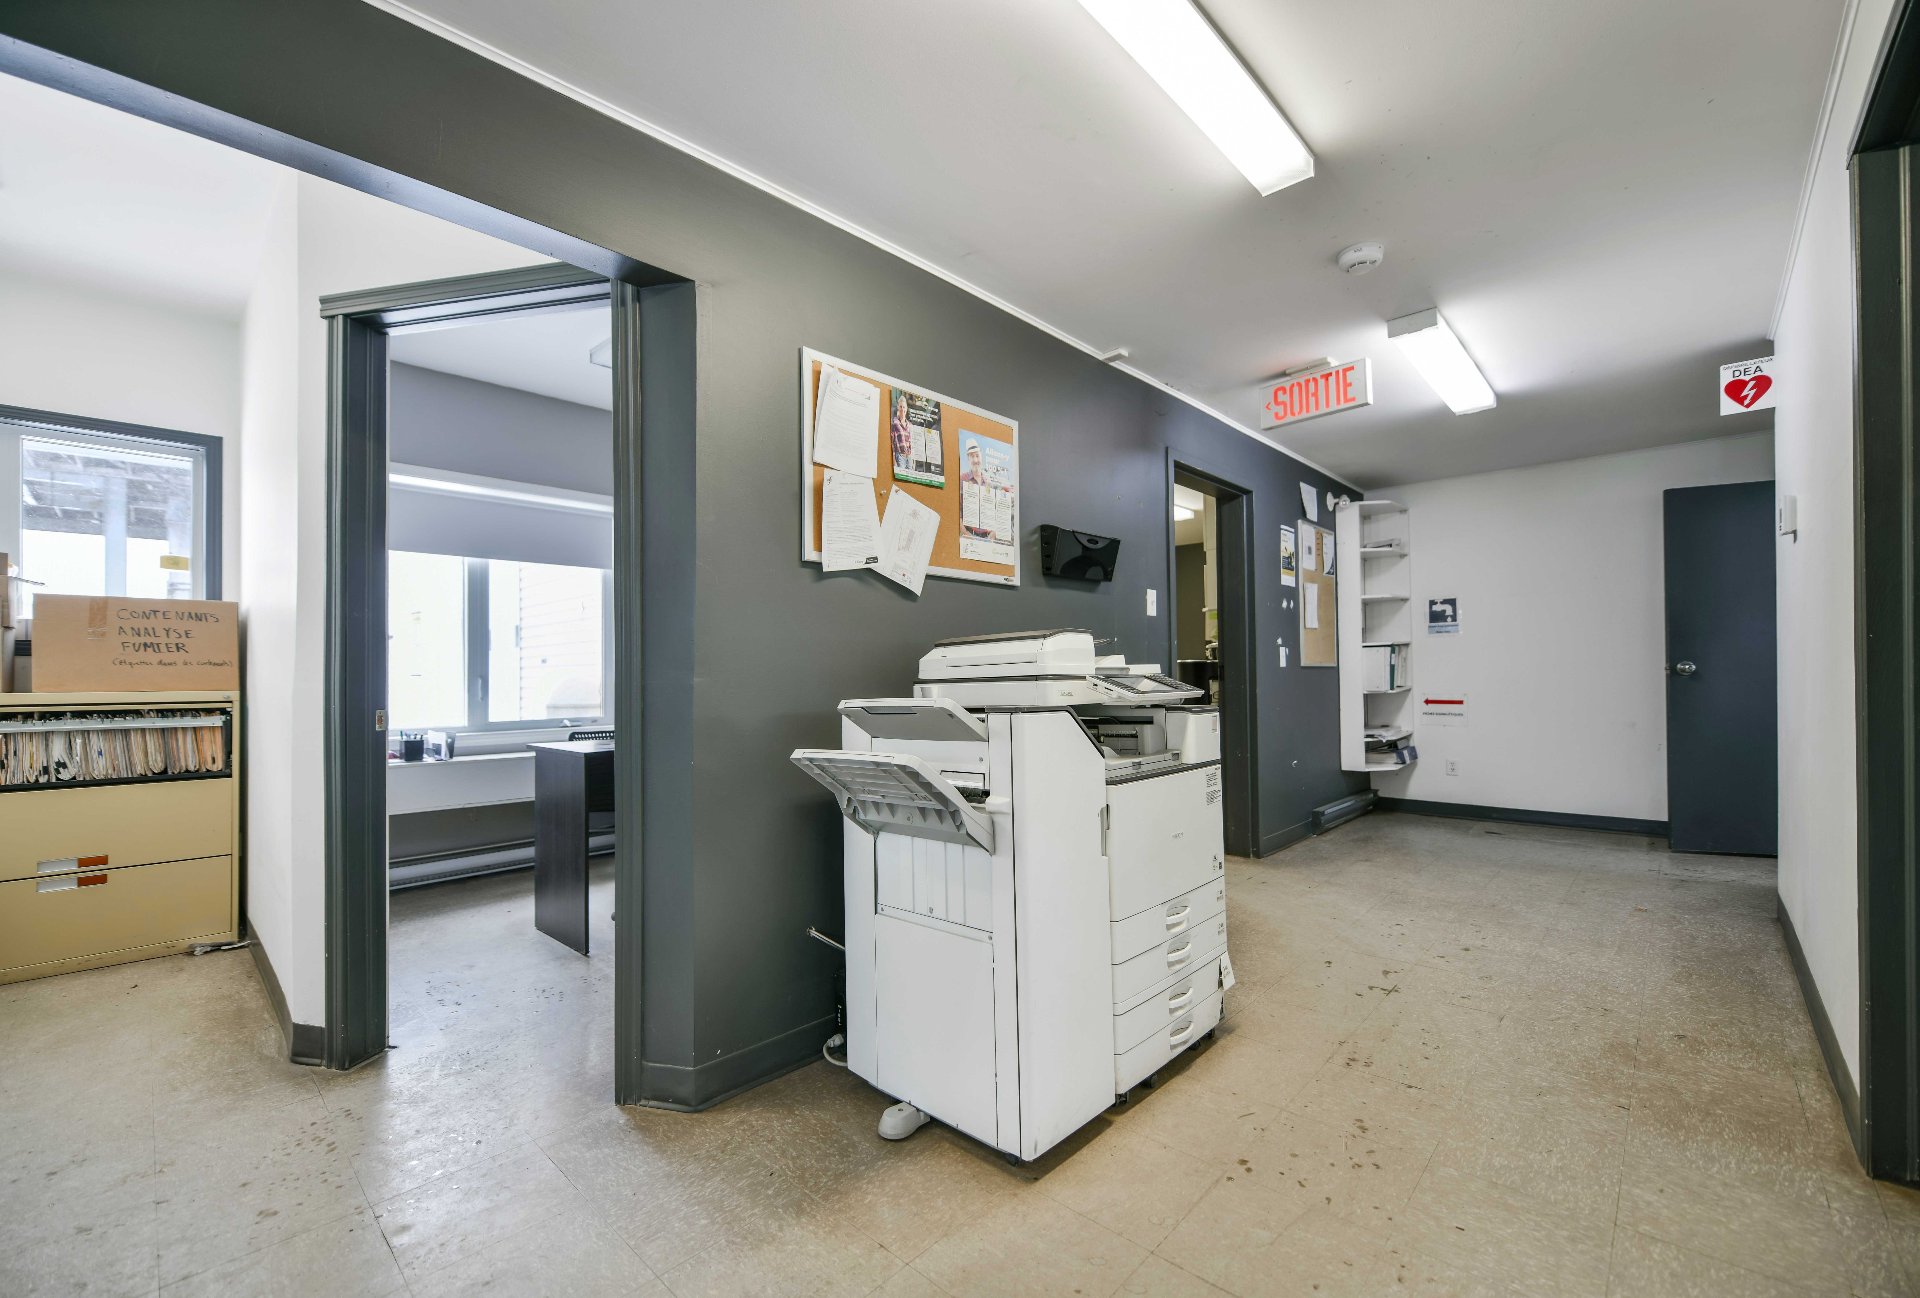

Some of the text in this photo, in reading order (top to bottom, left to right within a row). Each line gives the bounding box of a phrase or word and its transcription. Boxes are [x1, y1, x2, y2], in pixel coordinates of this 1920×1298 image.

[1732, 365, 1763, 378] DEA
[1273, 365, 1356, 421] SORTIE
[117, 608, 219, 623] CONTENANTS
[118, 626, 195, 639] ANALYSE
[121, 641, 189, 653] FUMIER
